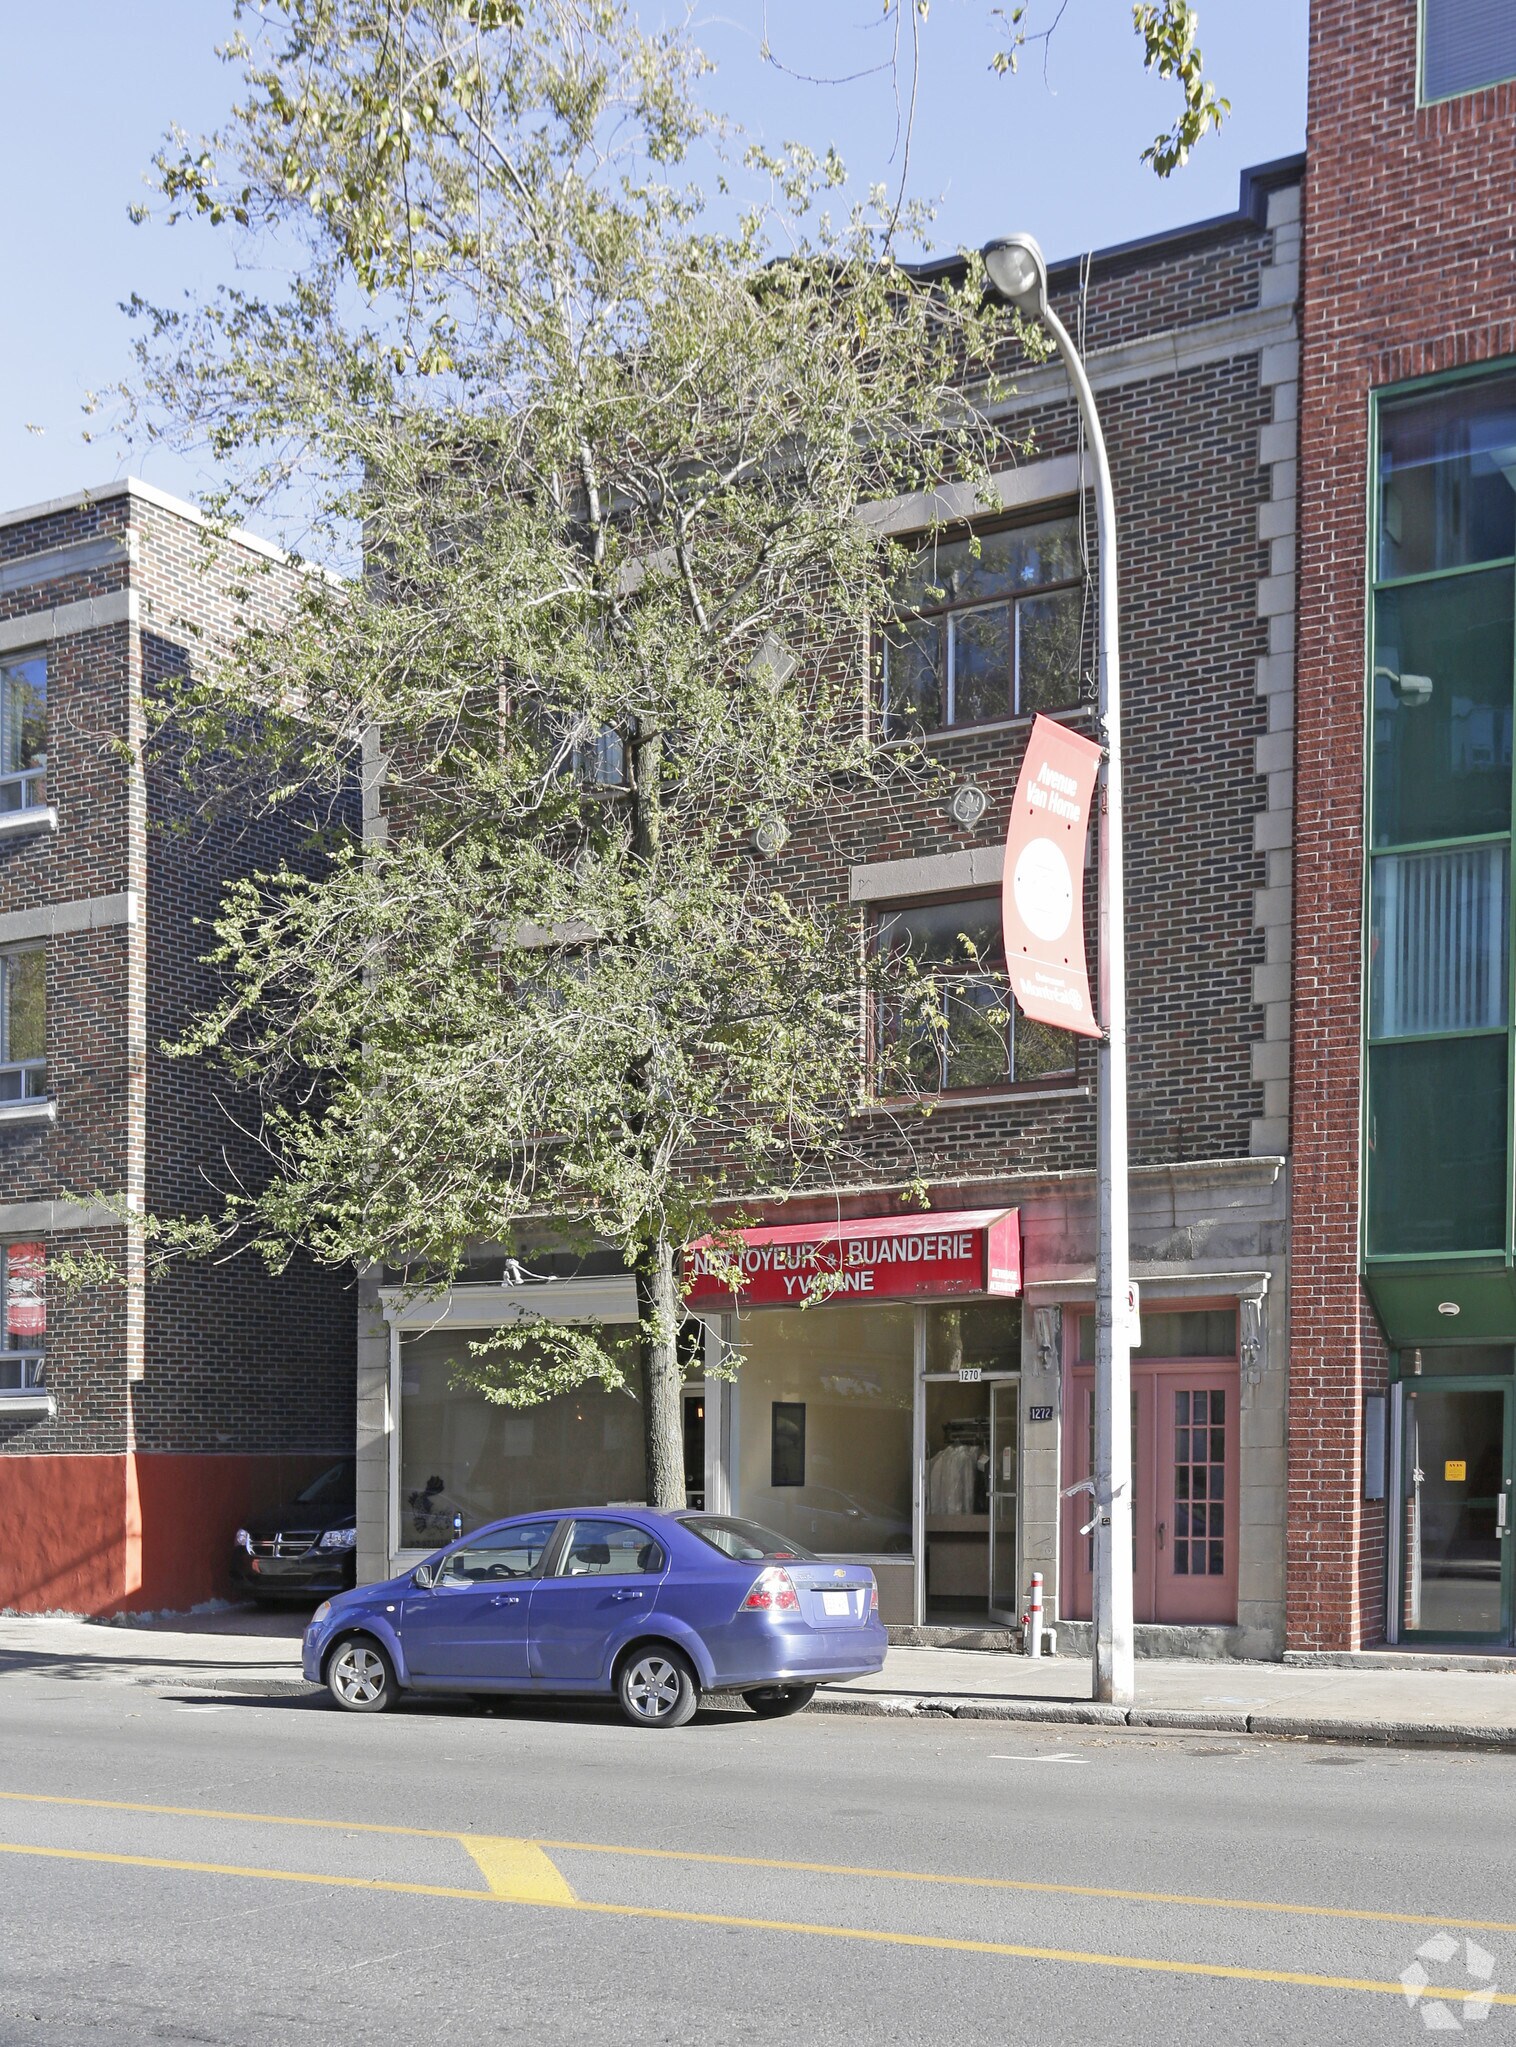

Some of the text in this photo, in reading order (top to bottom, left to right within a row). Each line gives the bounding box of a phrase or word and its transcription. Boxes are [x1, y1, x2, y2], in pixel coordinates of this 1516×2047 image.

[1038, 763, 1077, 797] Avenue
[1027, 780, 1081, 822] Van Horne
[849, 1234, 973, 1265] BUANDERIE
[783, 1271, 874, 1296] YVNE
[961, 1370, 979, 1381] 1270
[1031, 1408, 1051, 1419] 1272
